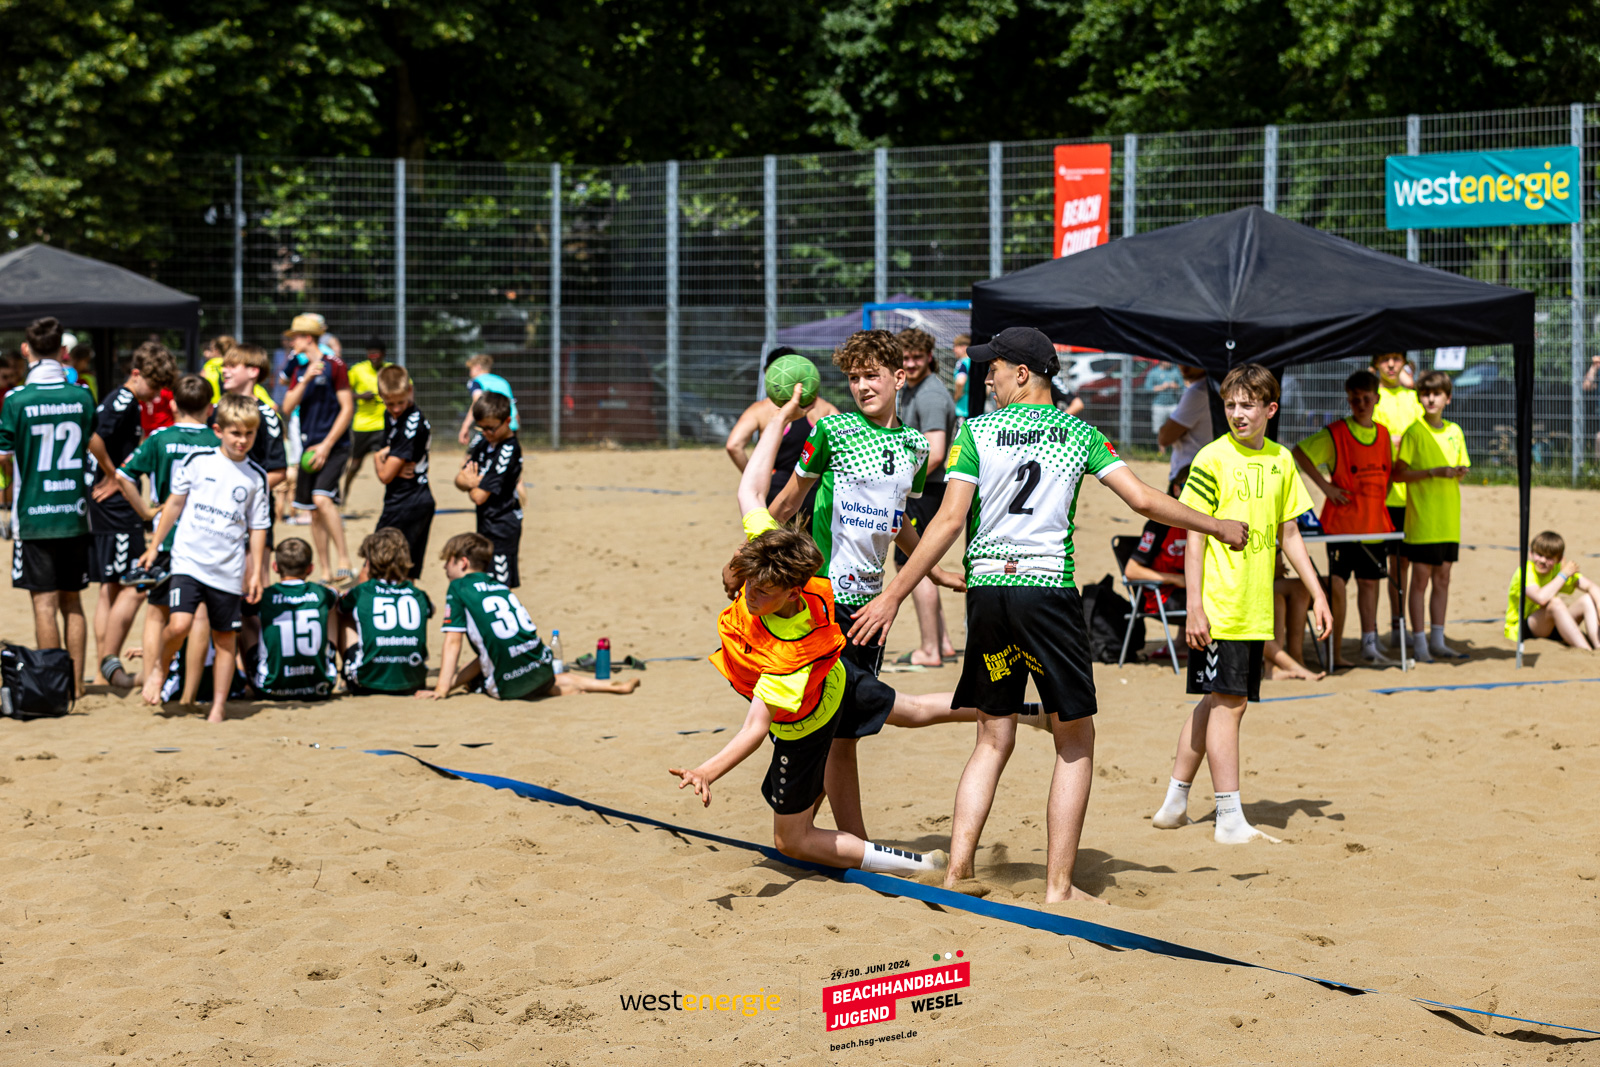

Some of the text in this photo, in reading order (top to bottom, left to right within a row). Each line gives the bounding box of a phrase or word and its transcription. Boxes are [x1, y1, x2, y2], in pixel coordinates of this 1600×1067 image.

[1394, 161, 1570, 210] westenergie
[1062, 194, 1102, 228] BEACH
[31, 421, 82, 472] 72
[997, 426, 1068, 446] Hülser SV
[883, 450, 894, 475] 3
[1008, 460, 1041, 515] 2
[840, 515, 888, 531] Krefeld eG
[841, 501, 889, 517] Volksbank
[1303, 511, 1318, 526] 2
[373, 595, 421, 630] 50
[272, 609, 322, 657] 15
[983, 645, 1012, 663] Kanal
